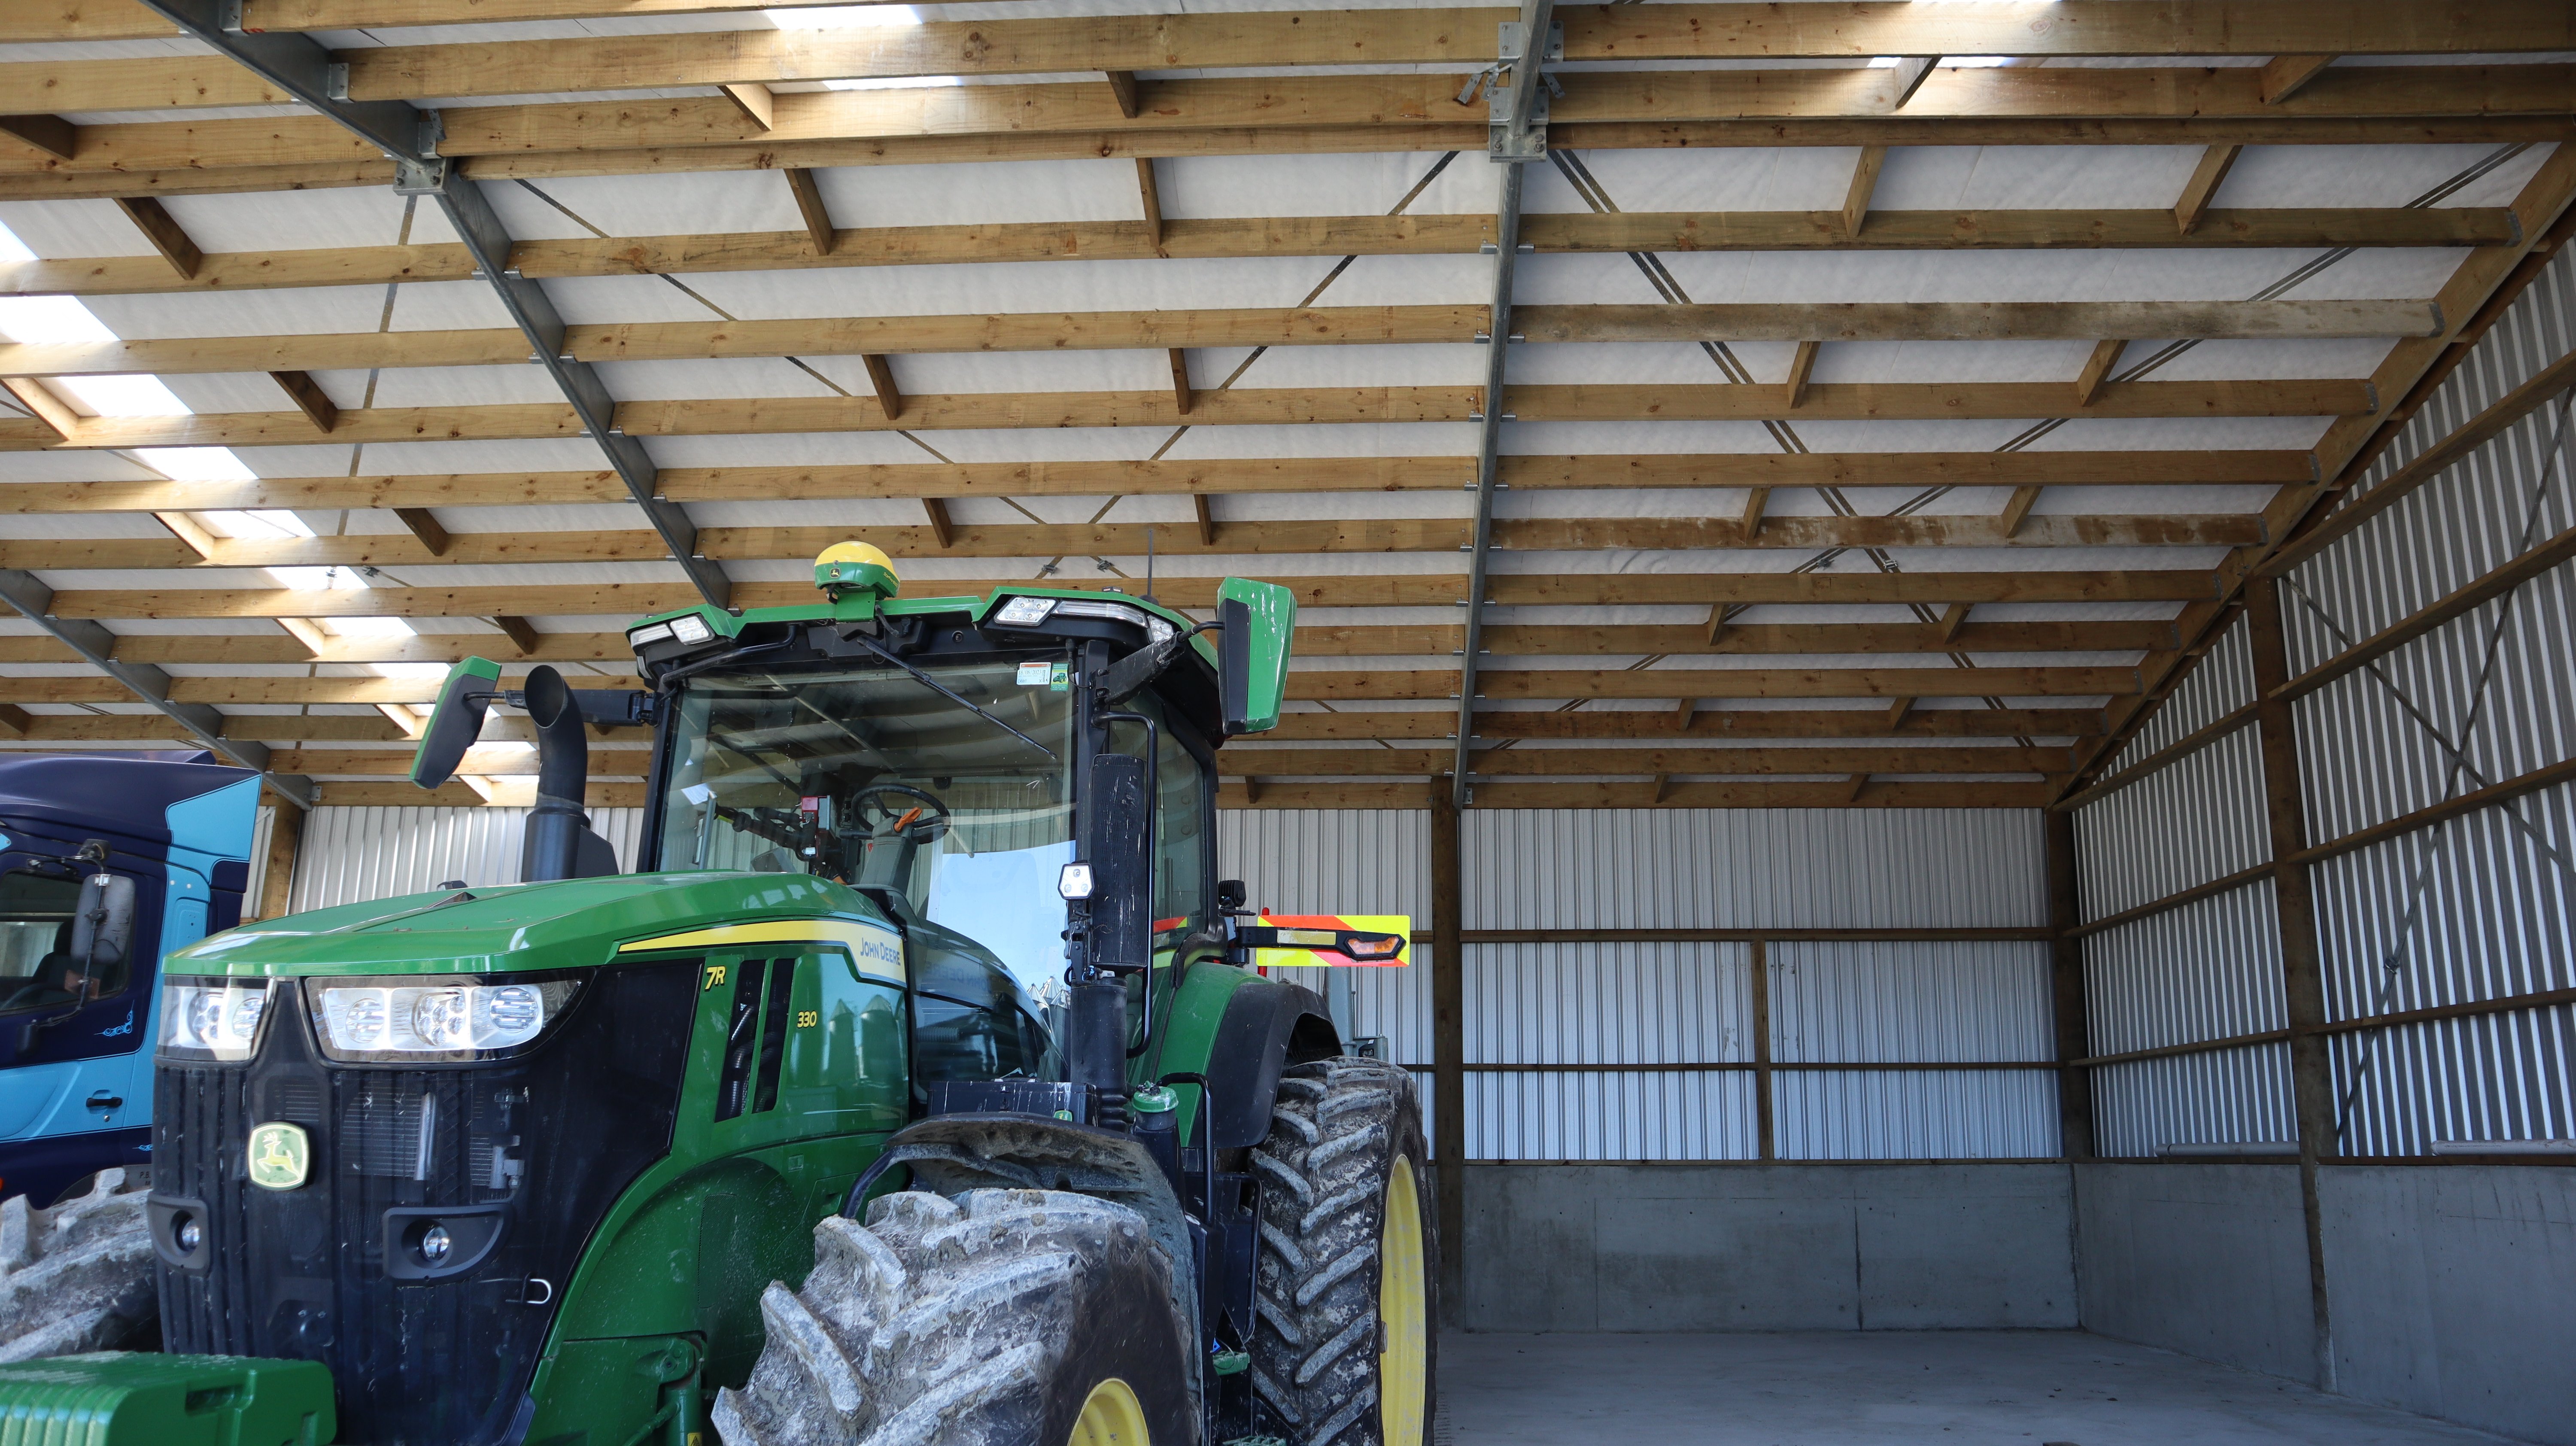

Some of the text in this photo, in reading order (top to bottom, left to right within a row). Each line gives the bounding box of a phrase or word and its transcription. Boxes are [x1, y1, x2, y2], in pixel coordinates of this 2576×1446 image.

[860, 937, 901, 966] JOHN DEERE
[705, 966, 726, 991] 7R
[797, 1010, 817, 1028] 330
